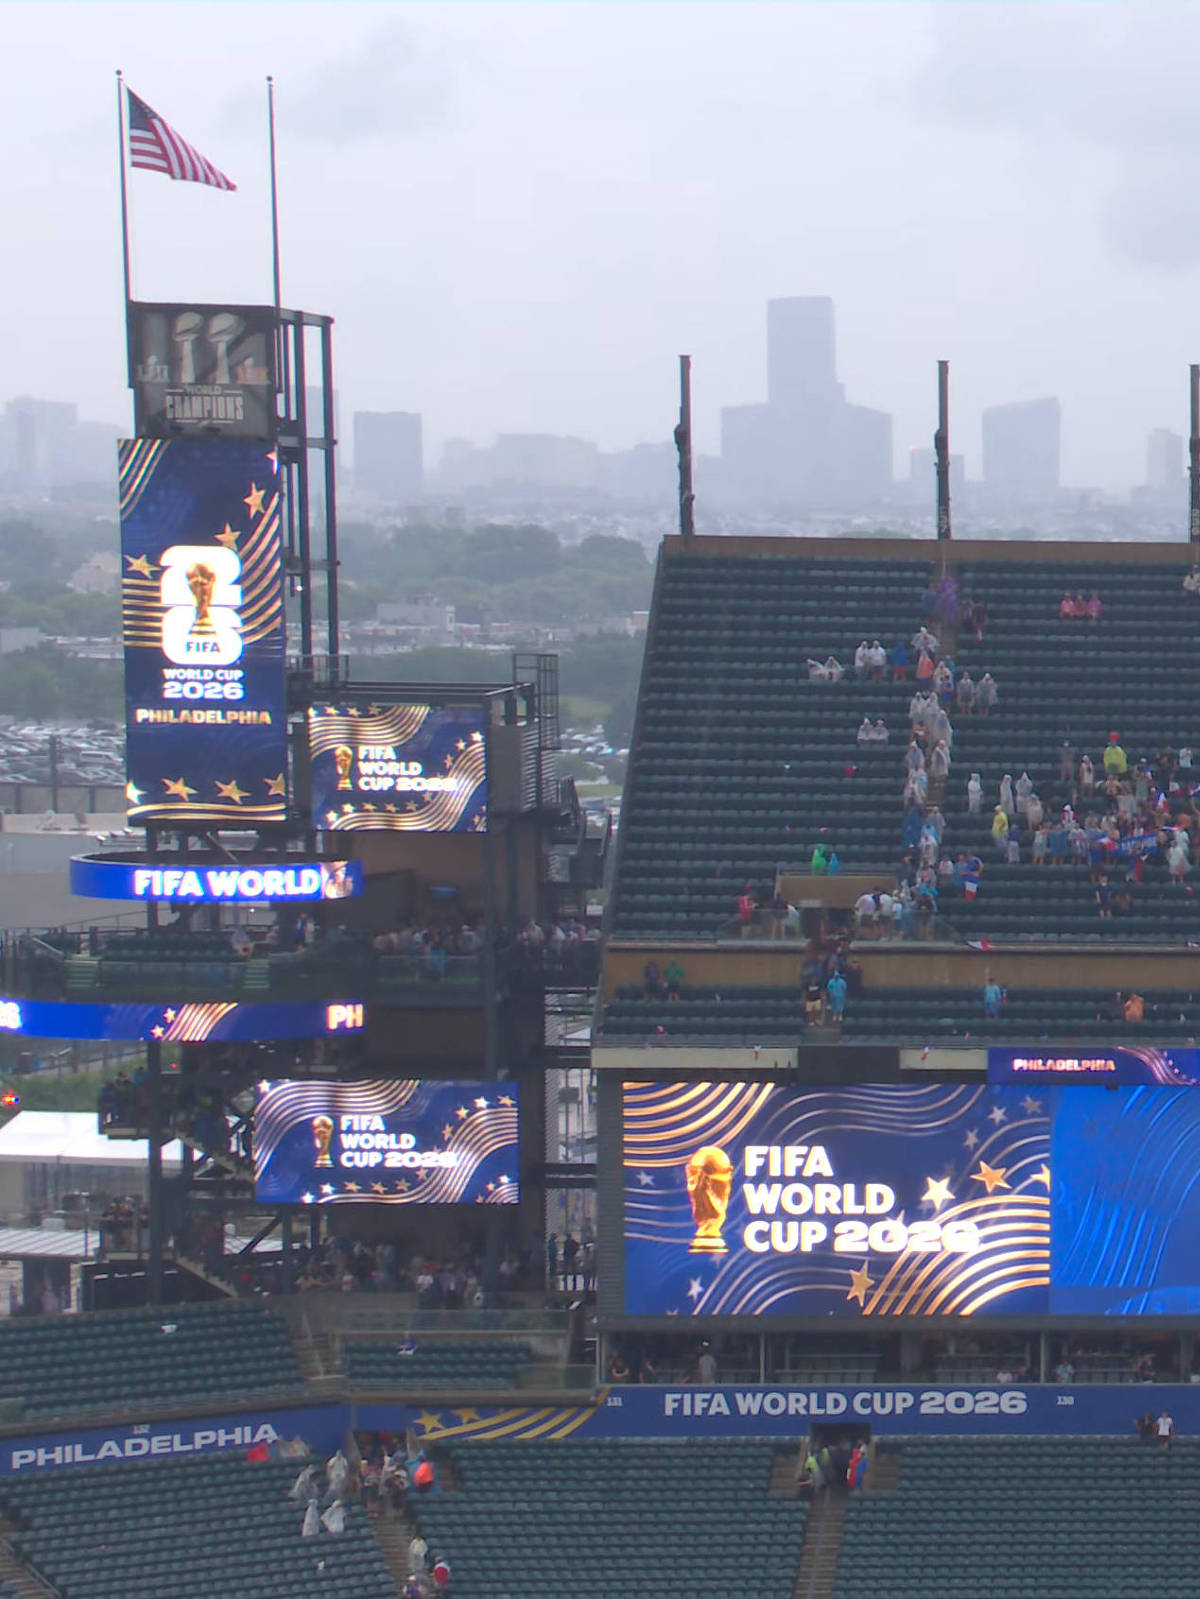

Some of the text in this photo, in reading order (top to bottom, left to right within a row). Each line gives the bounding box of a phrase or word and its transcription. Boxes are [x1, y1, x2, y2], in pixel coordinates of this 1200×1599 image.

[165, 395, 243, 419] CHAMPIONS
[185, 641, 221, 654] FIFA
[163, 669, 243, 682] WORLD CUP
[163, 682, 243, 700] 2026
[136, 709, 271, 725] PHILADELPHIA
[358, 745, 397, 760] FIFA
[358, 761, 423, 776] WORLD
[358, 777, 395, 791] CUP
[134, 869, 320, 896] FIFA WORLD
[328, 1004, 363, 1029] PH
[1013, 1059, 1116, 1072] PHILADELPHIA
[340, 1115, 385, 1131] FIFA
[340, 1133, 416, 1149] WORLD
[340, 1151, 457, 1167] CUP 2026
[744, 1145, 834, 1177] FIFA
[743, 1183, 895, 1214] WORLD
[744, 1221, 980, 1253] CUP 2026
[664, 1391, 1028, 1416] FIFA WORLD CUP 2026
[12, 1423, 278, 1469] PHILADELPHIA
